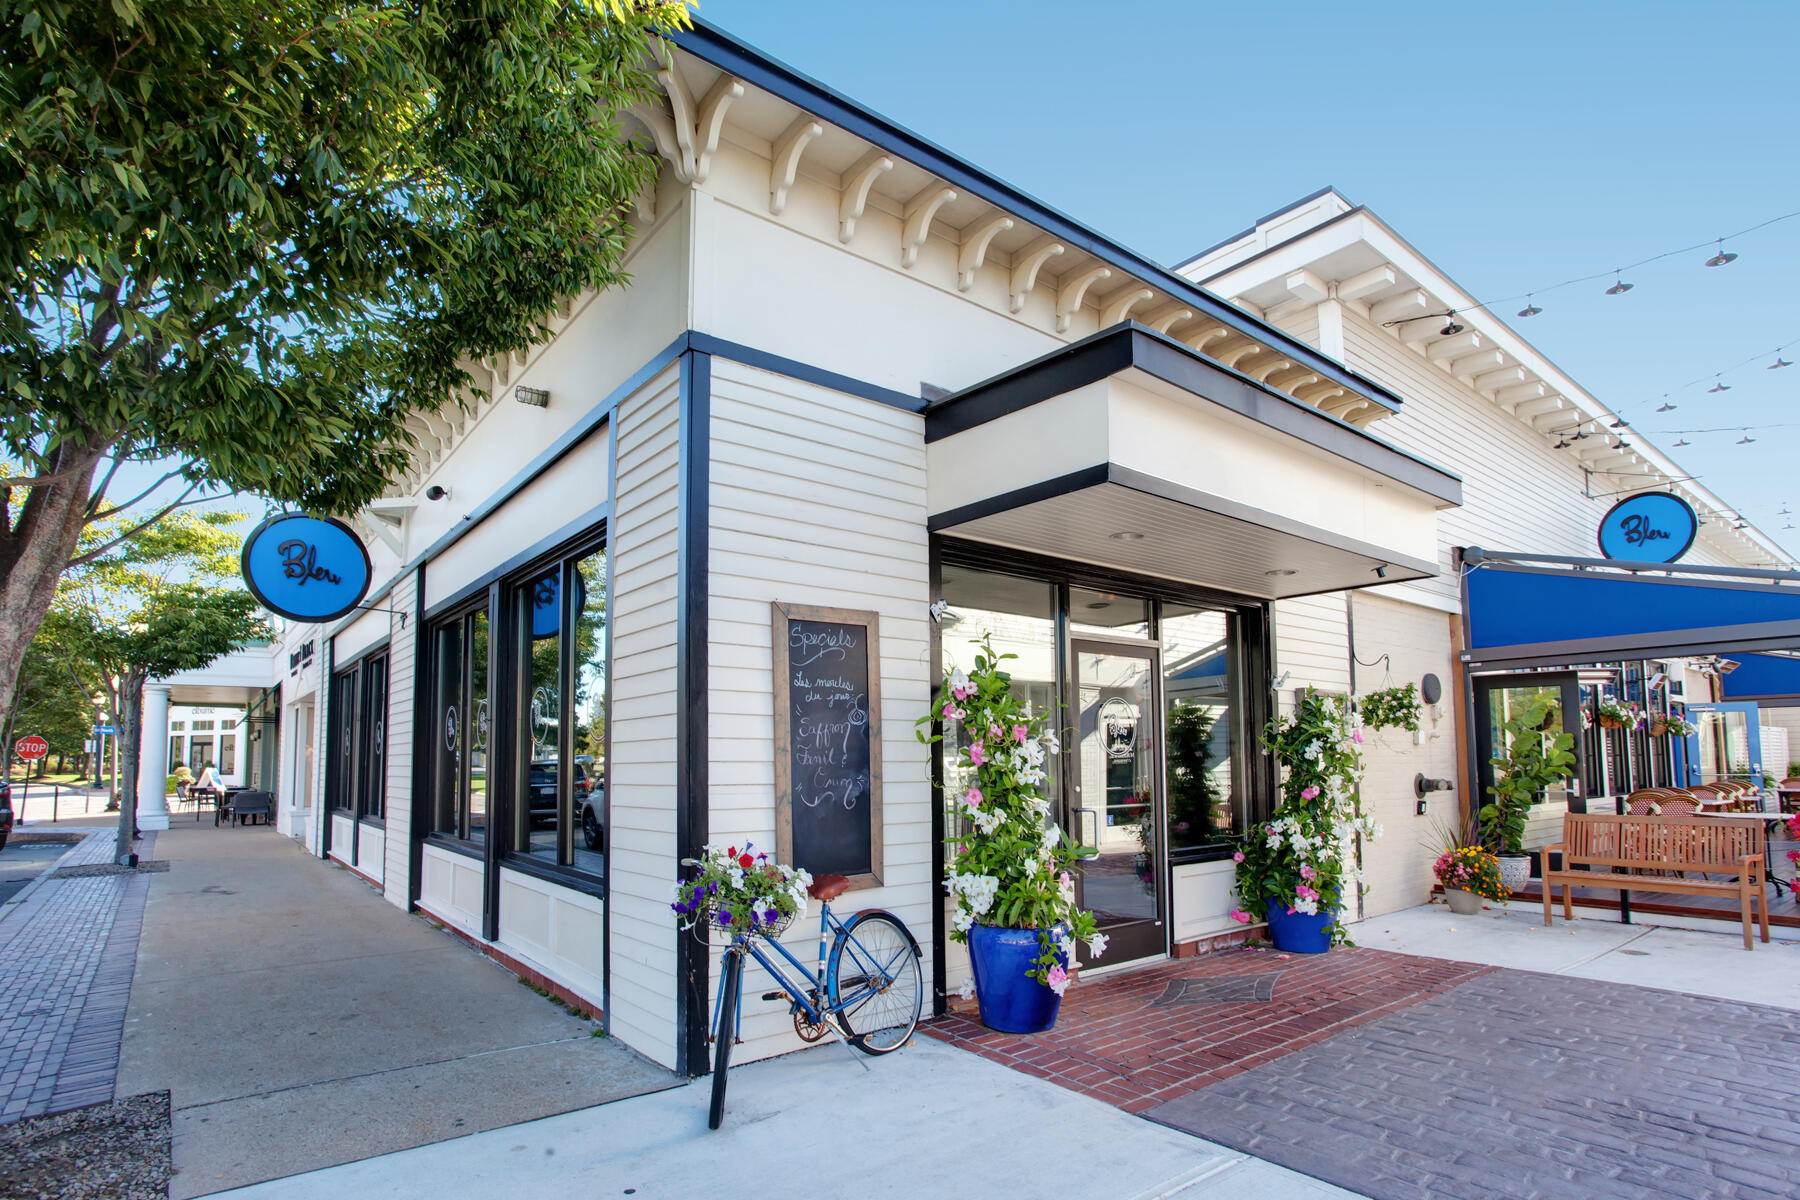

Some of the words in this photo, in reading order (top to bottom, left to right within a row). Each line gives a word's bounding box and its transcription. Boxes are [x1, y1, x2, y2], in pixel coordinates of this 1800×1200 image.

[1620, 514, 1671, 548] Bleu
[277, 538, 342, 586] Bleu
[790, 624, 857, 656] Specials
[18, 742, 47, 753] STOP
[799, 717, 851, 754] Saffron
